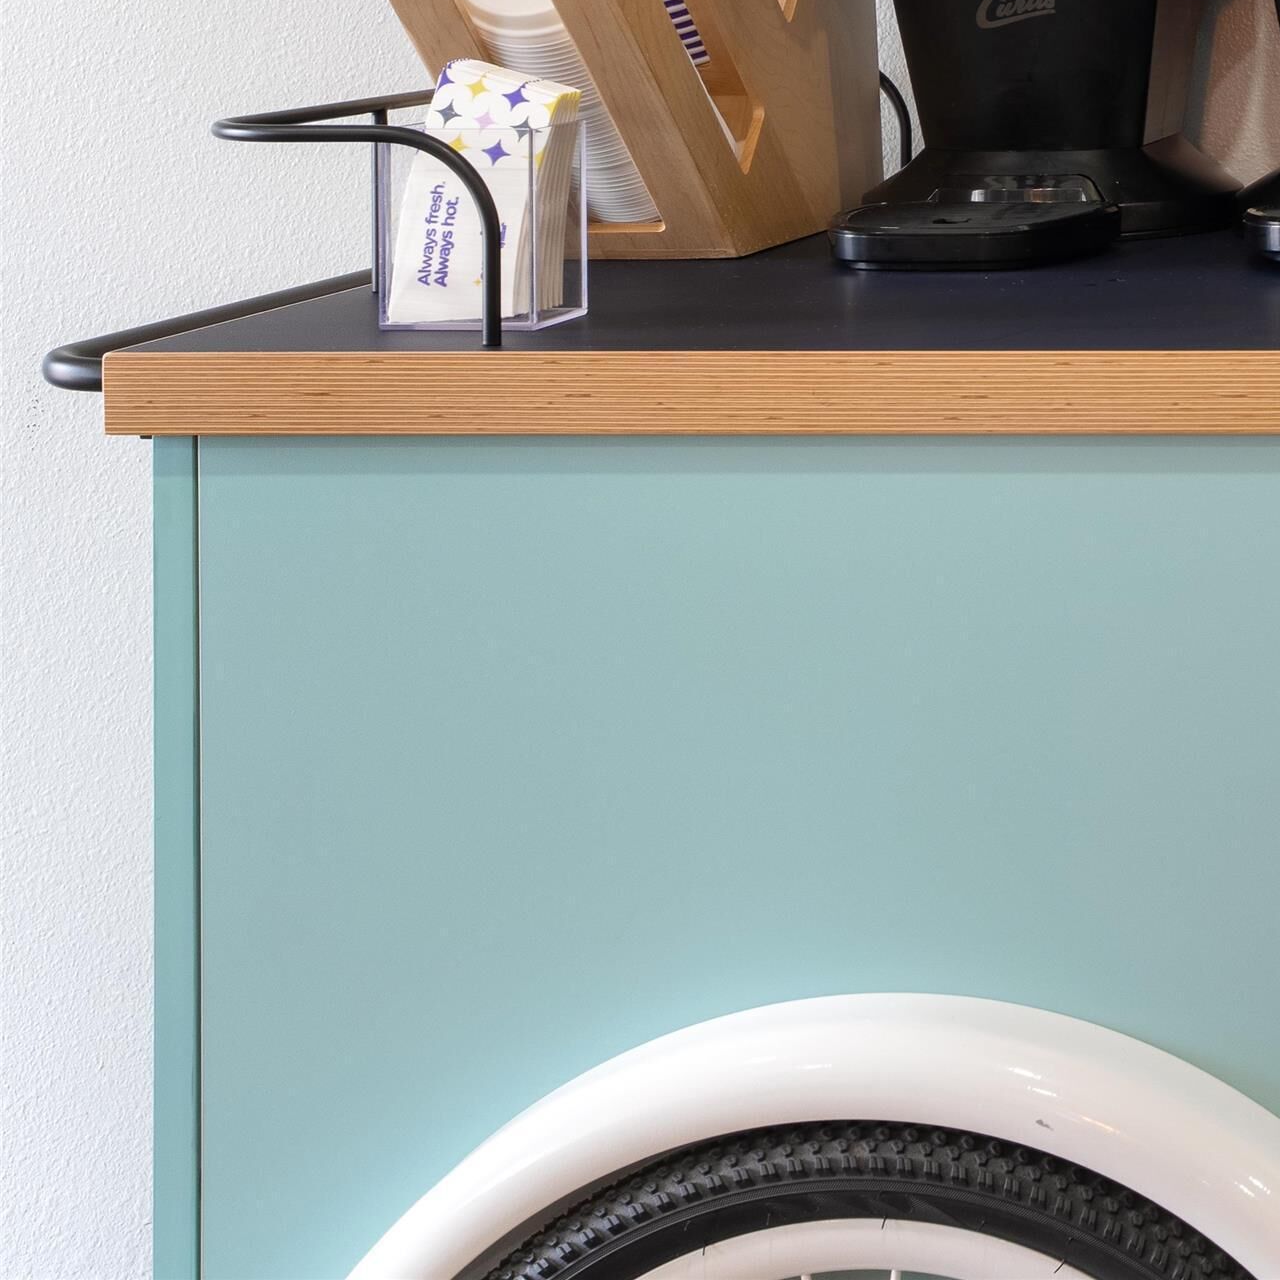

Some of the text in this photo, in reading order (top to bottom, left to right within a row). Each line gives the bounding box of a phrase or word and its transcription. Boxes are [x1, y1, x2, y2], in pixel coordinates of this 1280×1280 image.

[417, 181, 446, 286] Always fresh.
[433, 196, 460, 287] Always hot.
